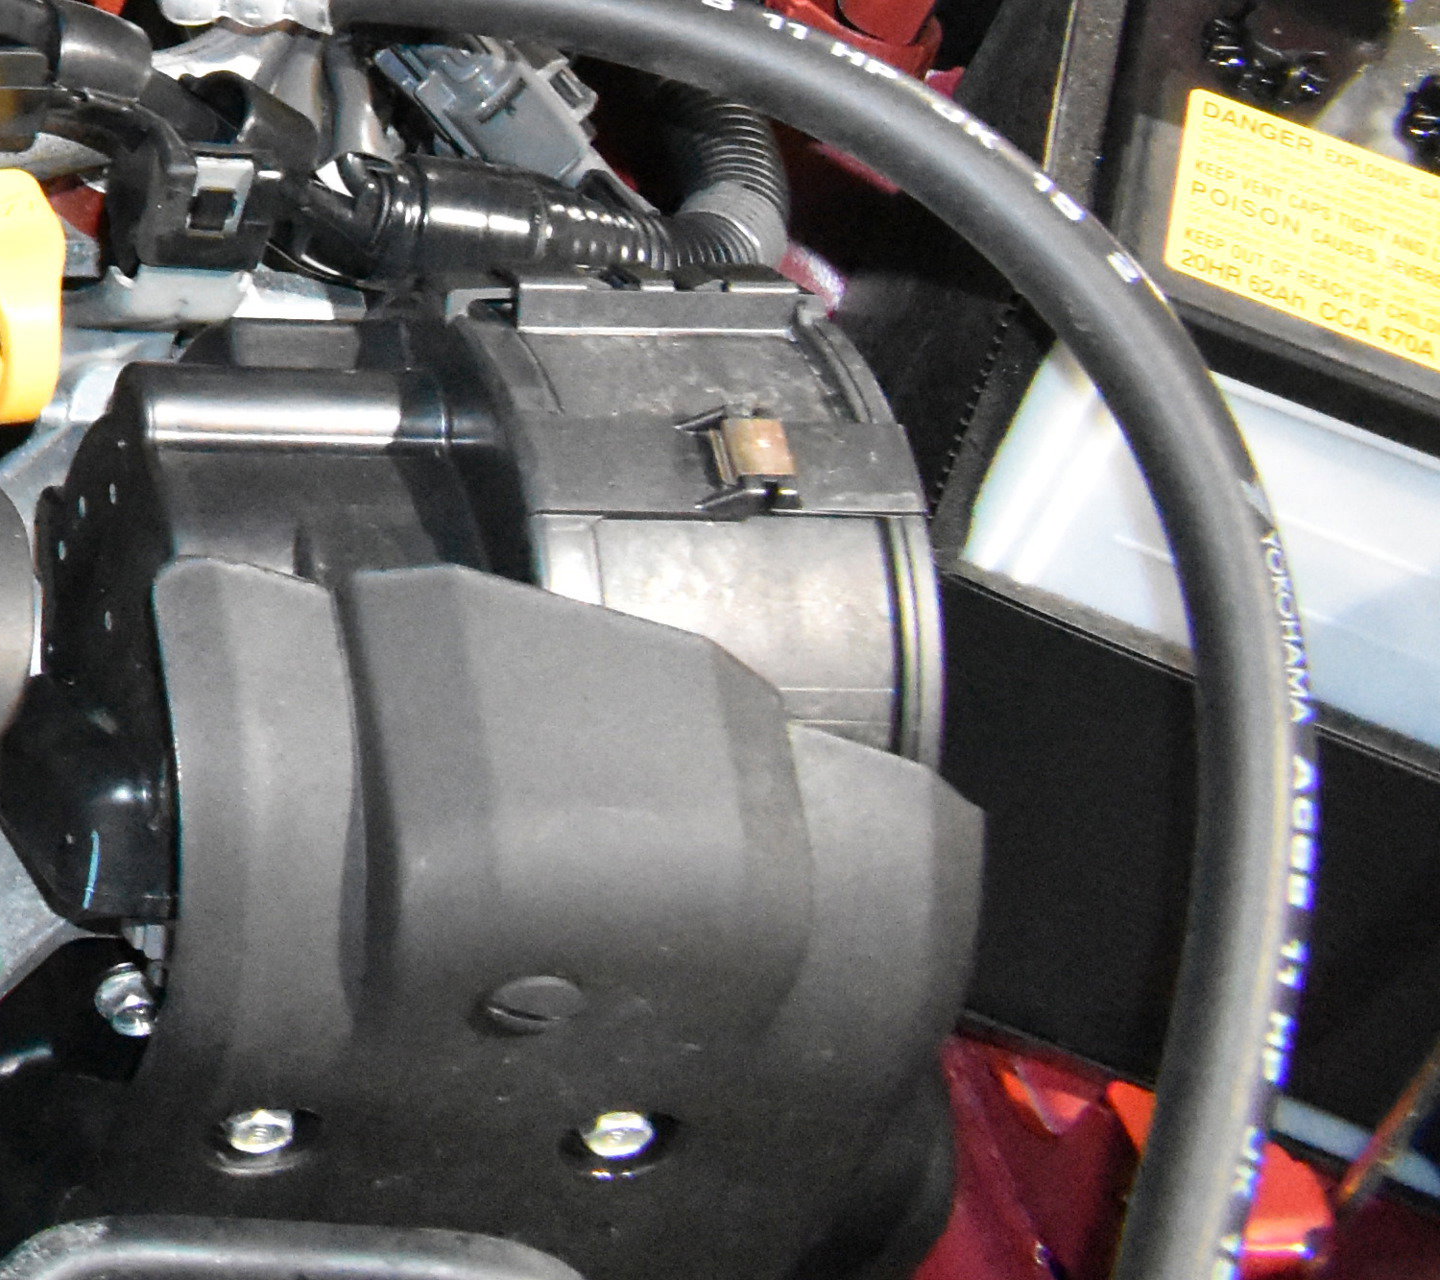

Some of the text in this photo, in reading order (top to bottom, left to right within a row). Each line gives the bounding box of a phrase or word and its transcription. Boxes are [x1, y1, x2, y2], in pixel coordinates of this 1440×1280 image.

[1201, 99, 1316, 155] DANGER
[1323, 147, 1413, 192] EXPLOSIVE
[1190, 179, 1302, 235] POISON
[1310, 227, 1378, 265] CAUSES
[1194, 159, 1236, 182] KEEP
[1240, 173, 1284, 199] VENT
[1288, 193, 1332, 221] CAPS
[1336, 211, 1387, 236] TIGHT
[1179, 246, 1243, 286] 20HR
[1246, 273, 1308, 313] 62Ah
[1316, 300, 1373, 335] CCA
[1377, 324, 1436, 359] 470A
[1183, 225, 1226, 249] KEEP
[1230, 243, 1266, 267] OUT
[1269, 257, 1293, 277] OF
[1296, 268, 1357, 302] REACH
[1358, 291, 1381, 311] OF
[1257, 527, 1314, 725] YOKOHAMA
